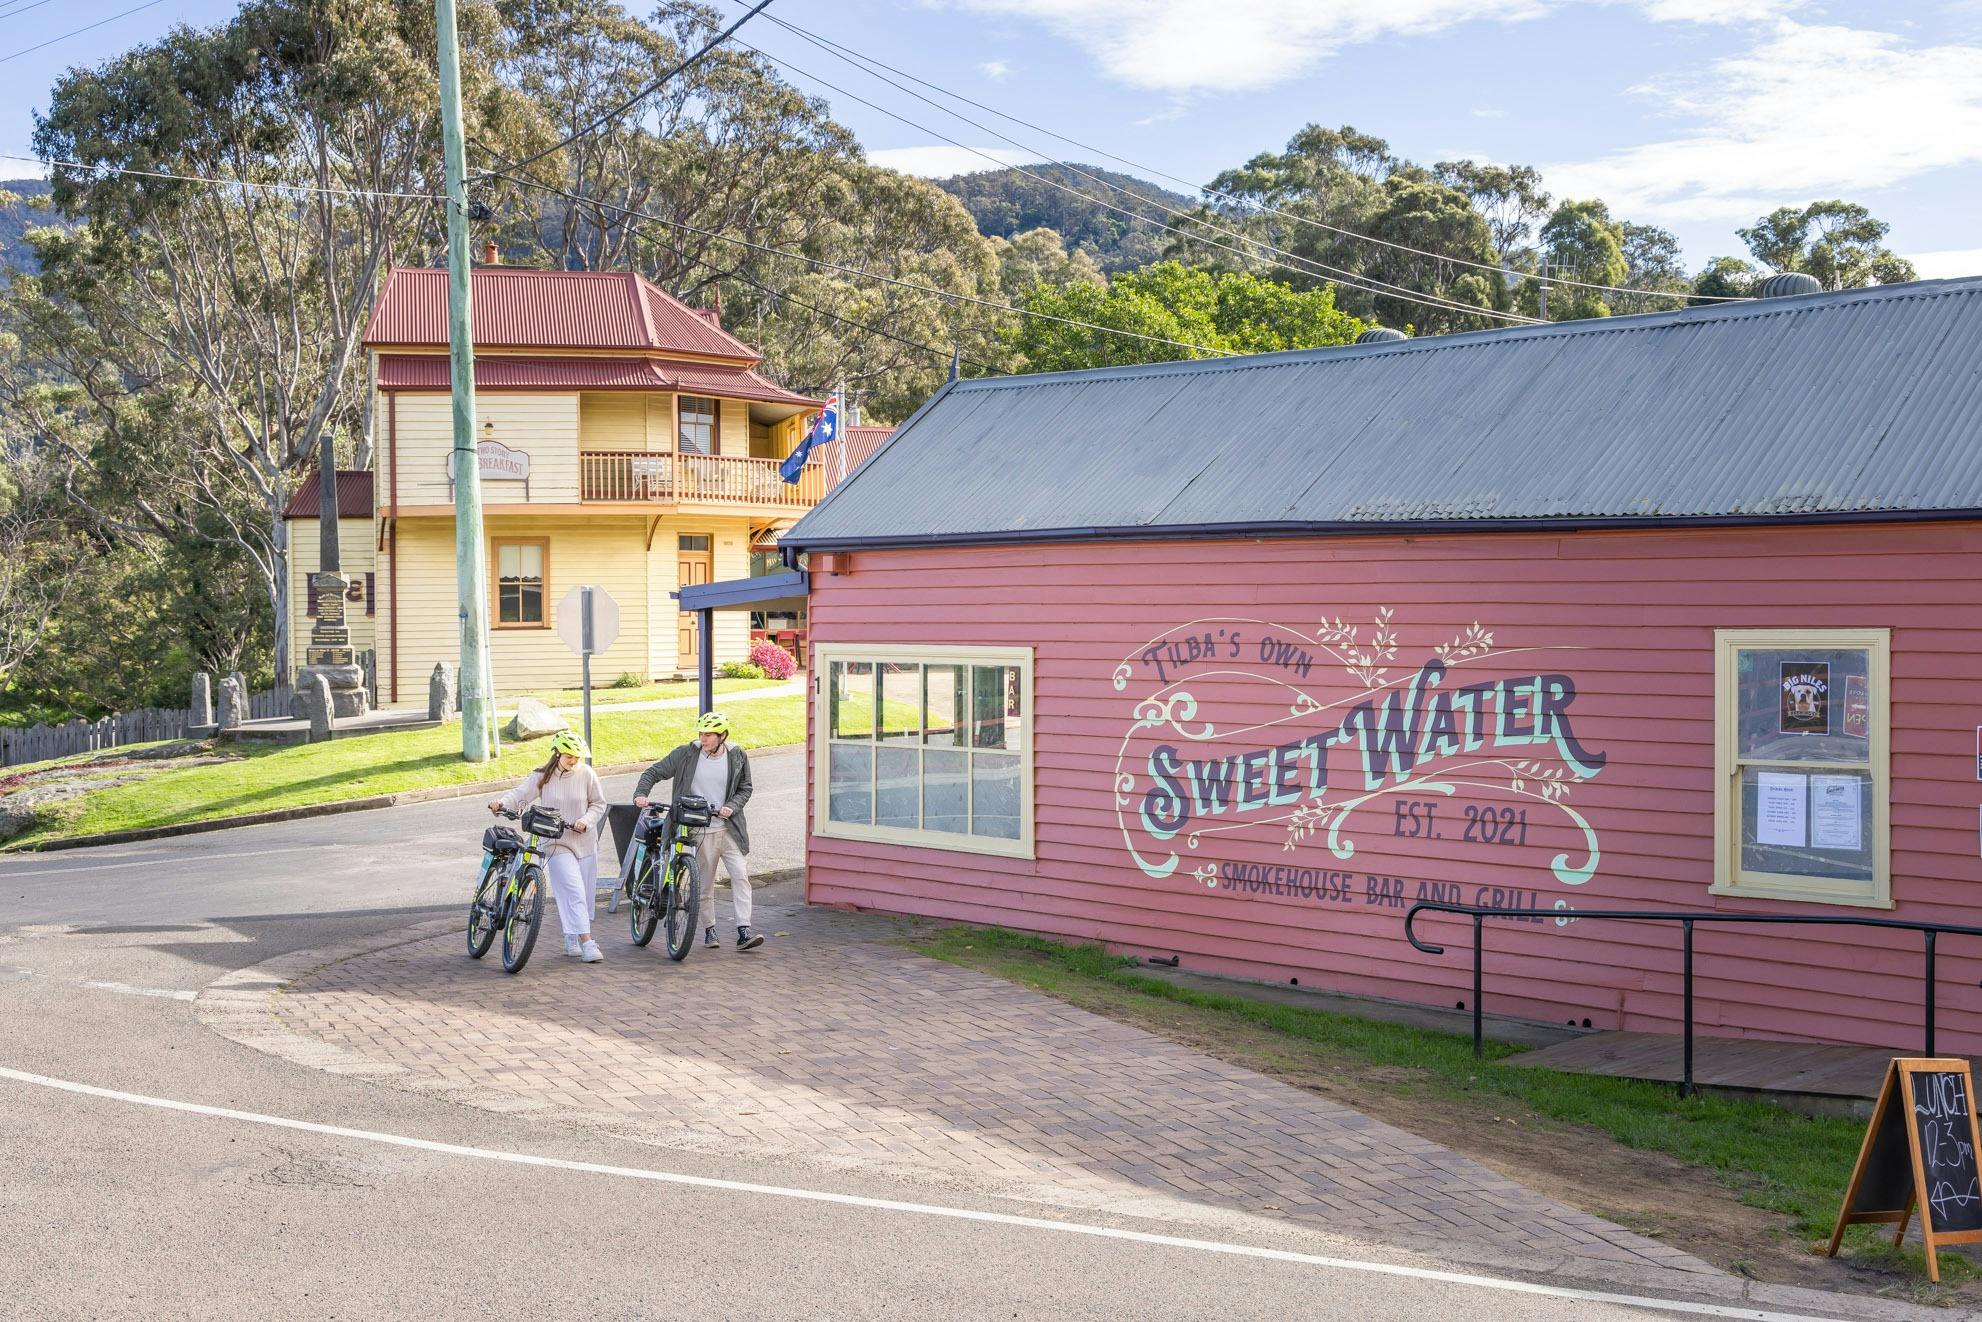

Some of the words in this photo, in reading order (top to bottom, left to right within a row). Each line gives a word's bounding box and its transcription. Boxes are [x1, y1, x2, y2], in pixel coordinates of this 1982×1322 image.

[478, 457, 523, 475] BREAKFAST
[1141, 629, 1241, 686] TILBA'S
[1259, 636, 1315, 679] OWN
[1008, 671, 1016, 709] BAR
[1782, 675, 1800, 690] BIG
[1800, 674, 1828, 693] NILES
[1138, 727, 1346, 840] SWEET
[1338, 658, 1606, 792] WATER
[1393, 799, 1442, 839] EST.
[1462, 804, 1528, 846] 2021
[1221, 862, 1353, 903] SMOKEHOUSE
[1366, 876, 1406, 908] BAR
[1416, 881, 1462, 911] AND
[1475, 886, 1544, 924] GRILL
[1911, 1073, 1969, 1119] LUNCH
